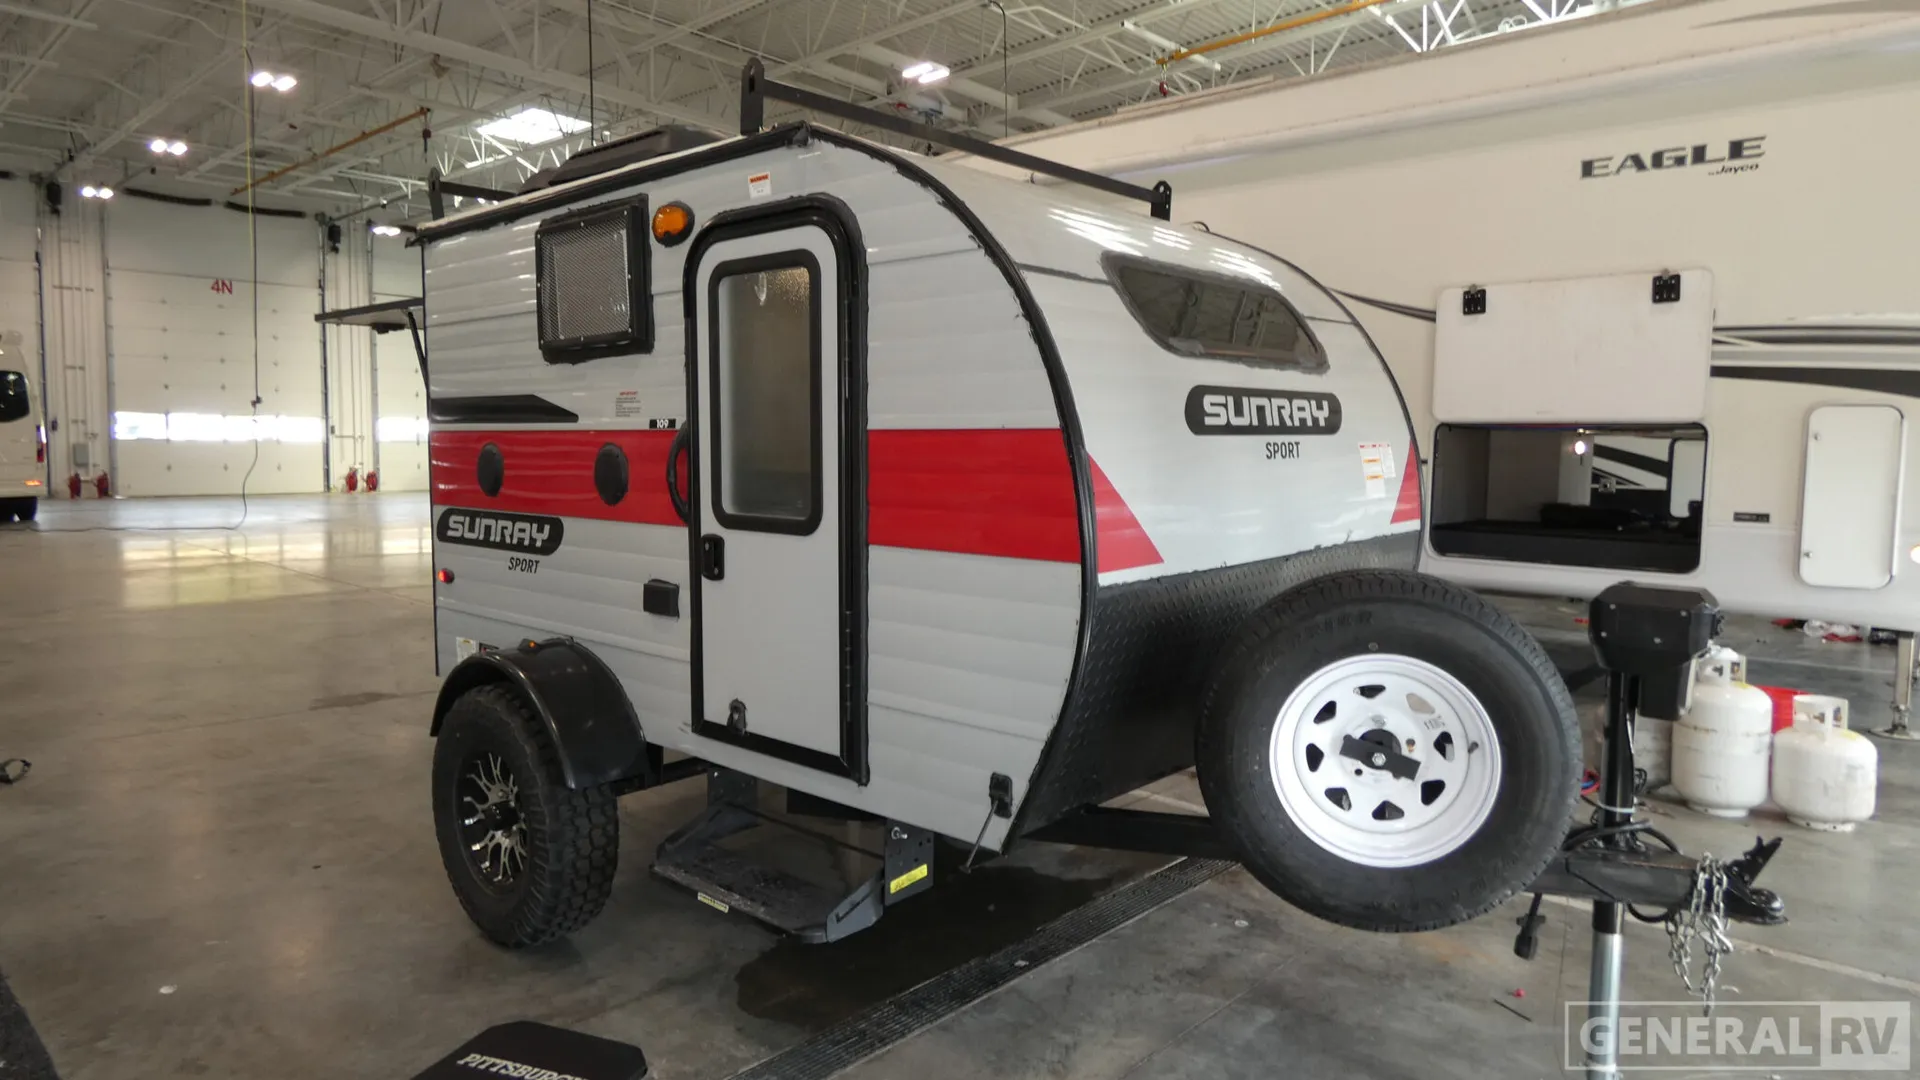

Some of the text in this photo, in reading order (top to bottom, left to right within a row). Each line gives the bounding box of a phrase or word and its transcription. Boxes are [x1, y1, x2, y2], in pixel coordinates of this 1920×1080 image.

[1580, 135, 1766, 179] EAGLE
[211, 278, 232, 295] 4N
[1203, 394, 1329, 427] SUNRAY
[1265, 441, 1301, 460] SPORT
[446, 515, 550, 547] SUNRAY
[508, 556, 540, 574] SPORT
